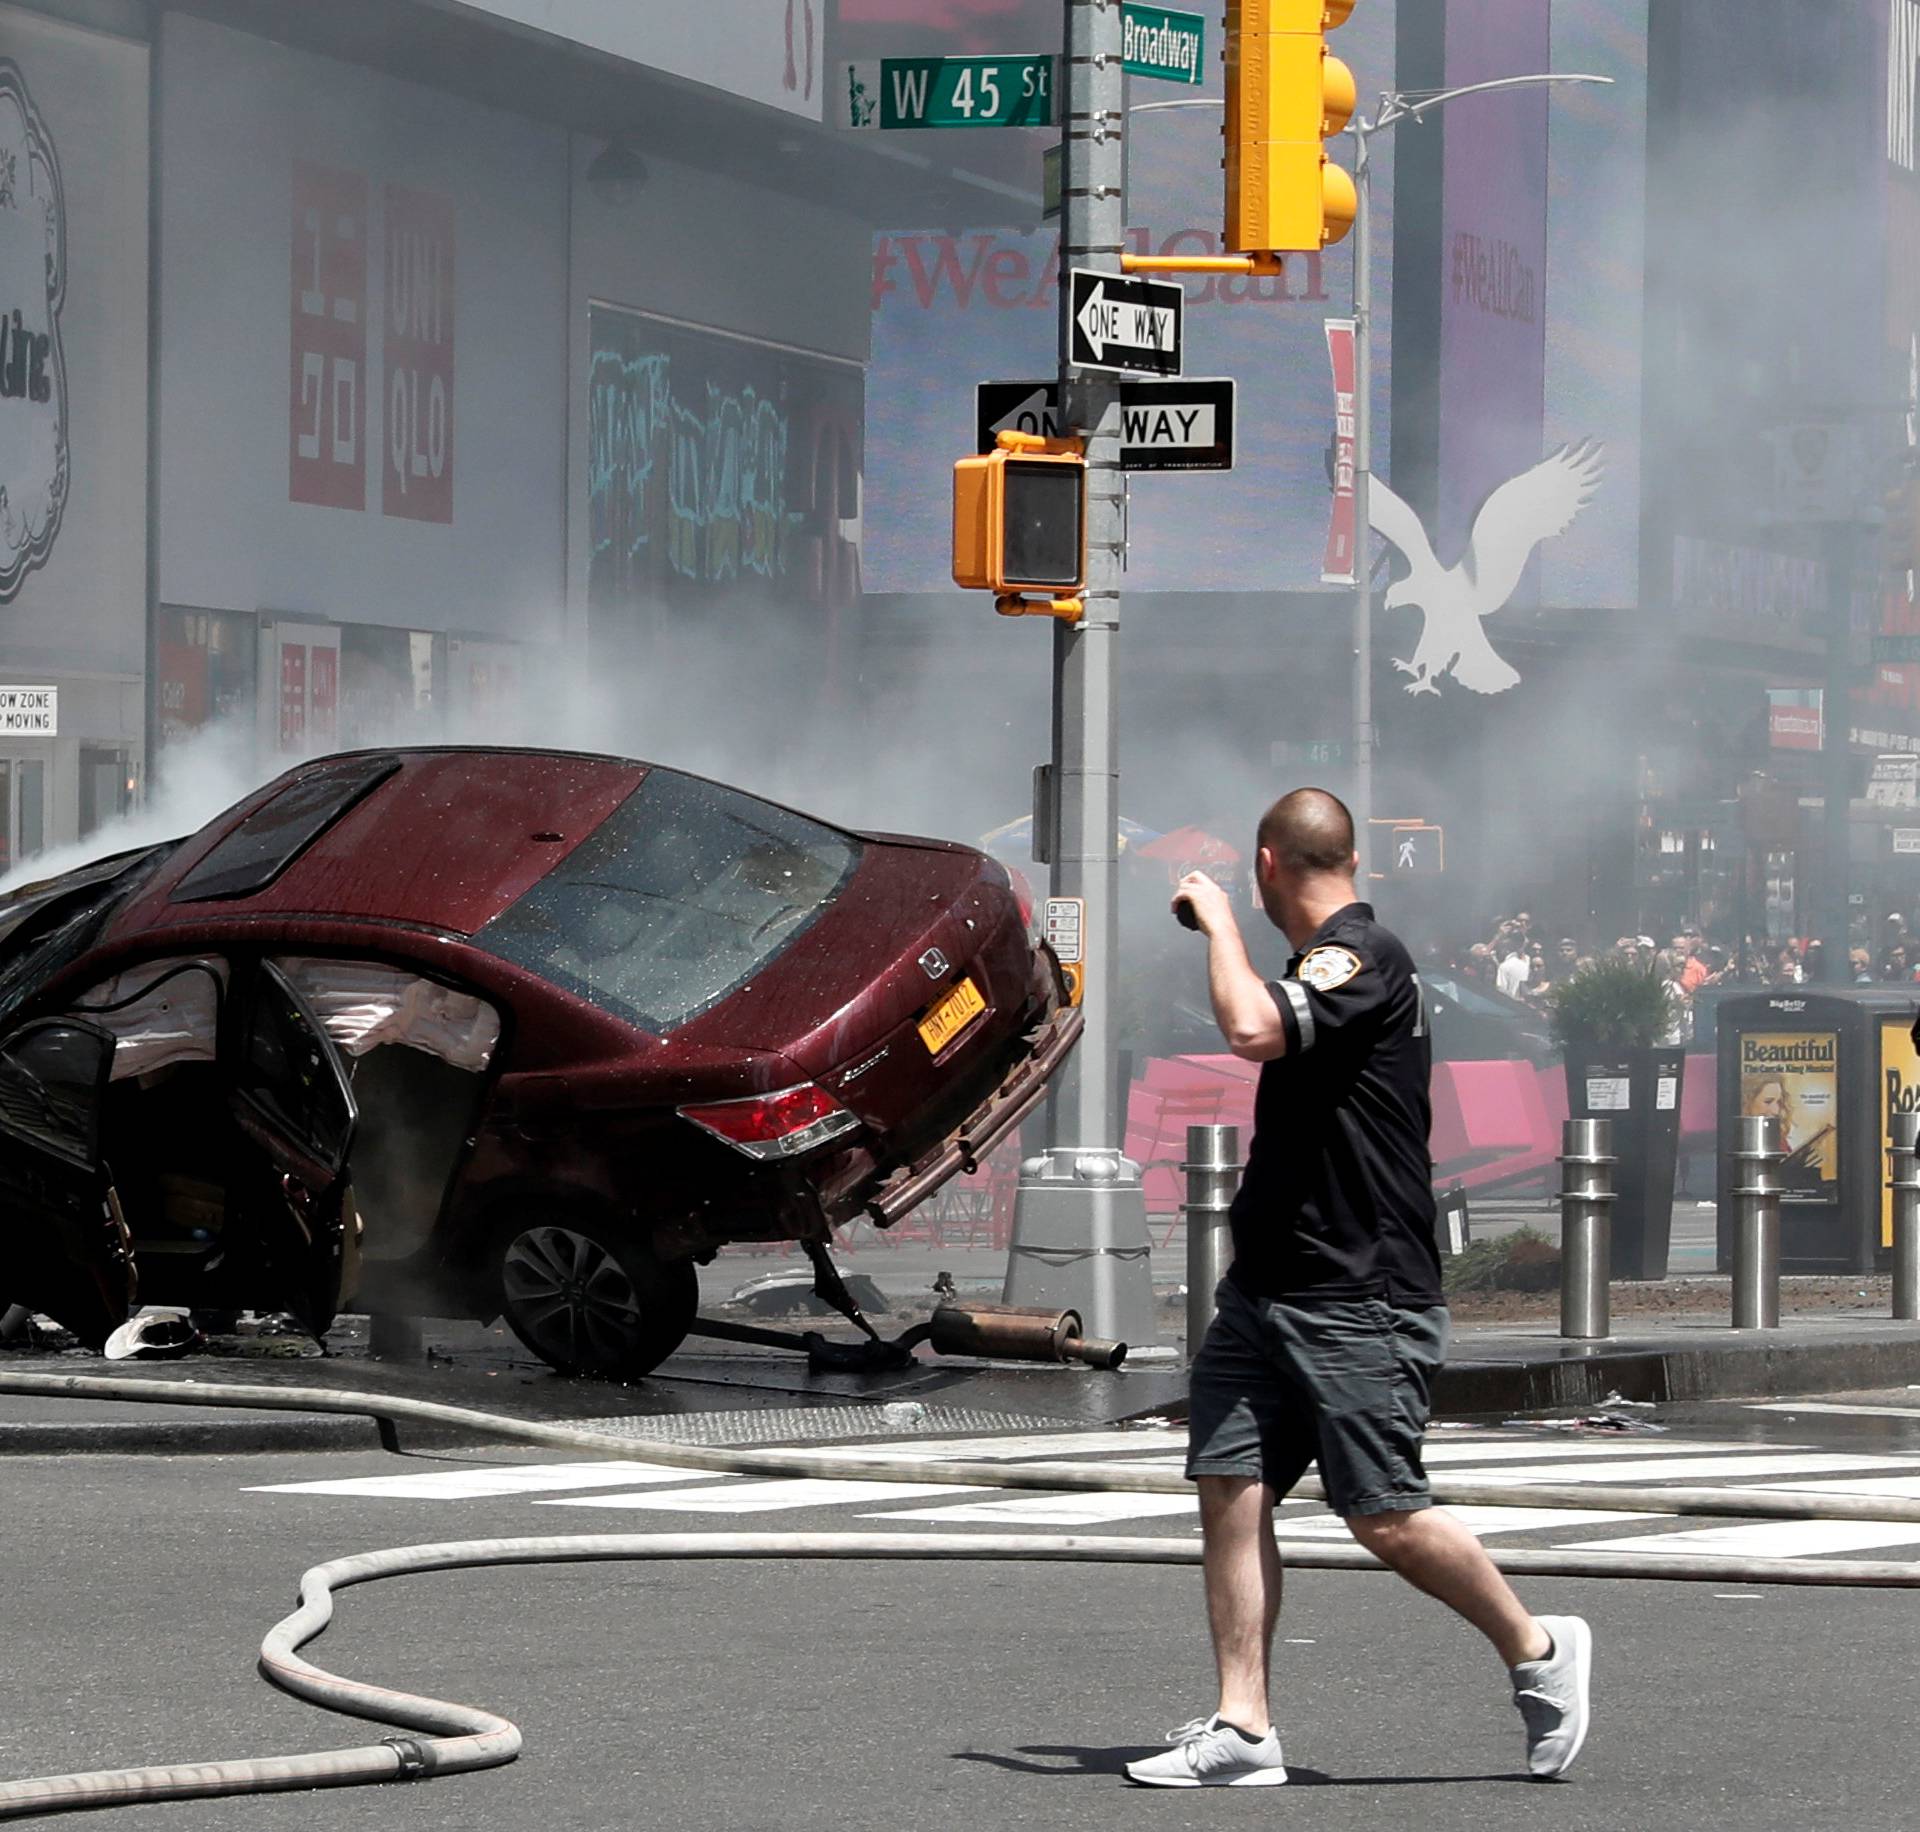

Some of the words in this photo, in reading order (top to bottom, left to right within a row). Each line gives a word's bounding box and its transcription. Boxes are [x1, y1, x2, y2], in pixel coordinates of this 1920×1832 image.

[1124, 15, 1199, 84] Broadway
[892, 69, 928, 119] W
[951, 68, 1000, 117] 45
[1021, 66, 1048, 97] St
[1088, 302, 1119, 340] ONE
[1134, 307, 1167, 349] WAY
[391, 366, 445, 494] QLO
[1016, 411, 1058, 438] ON
[1123, 410, 1199, 444] WAY
[0, 693, 17, 708] OW
[20, 693, 49, 708] ZONE
[6, 713, 50, 728] MOVING
[1743, 1038, 1835, 1062] Beautiful
